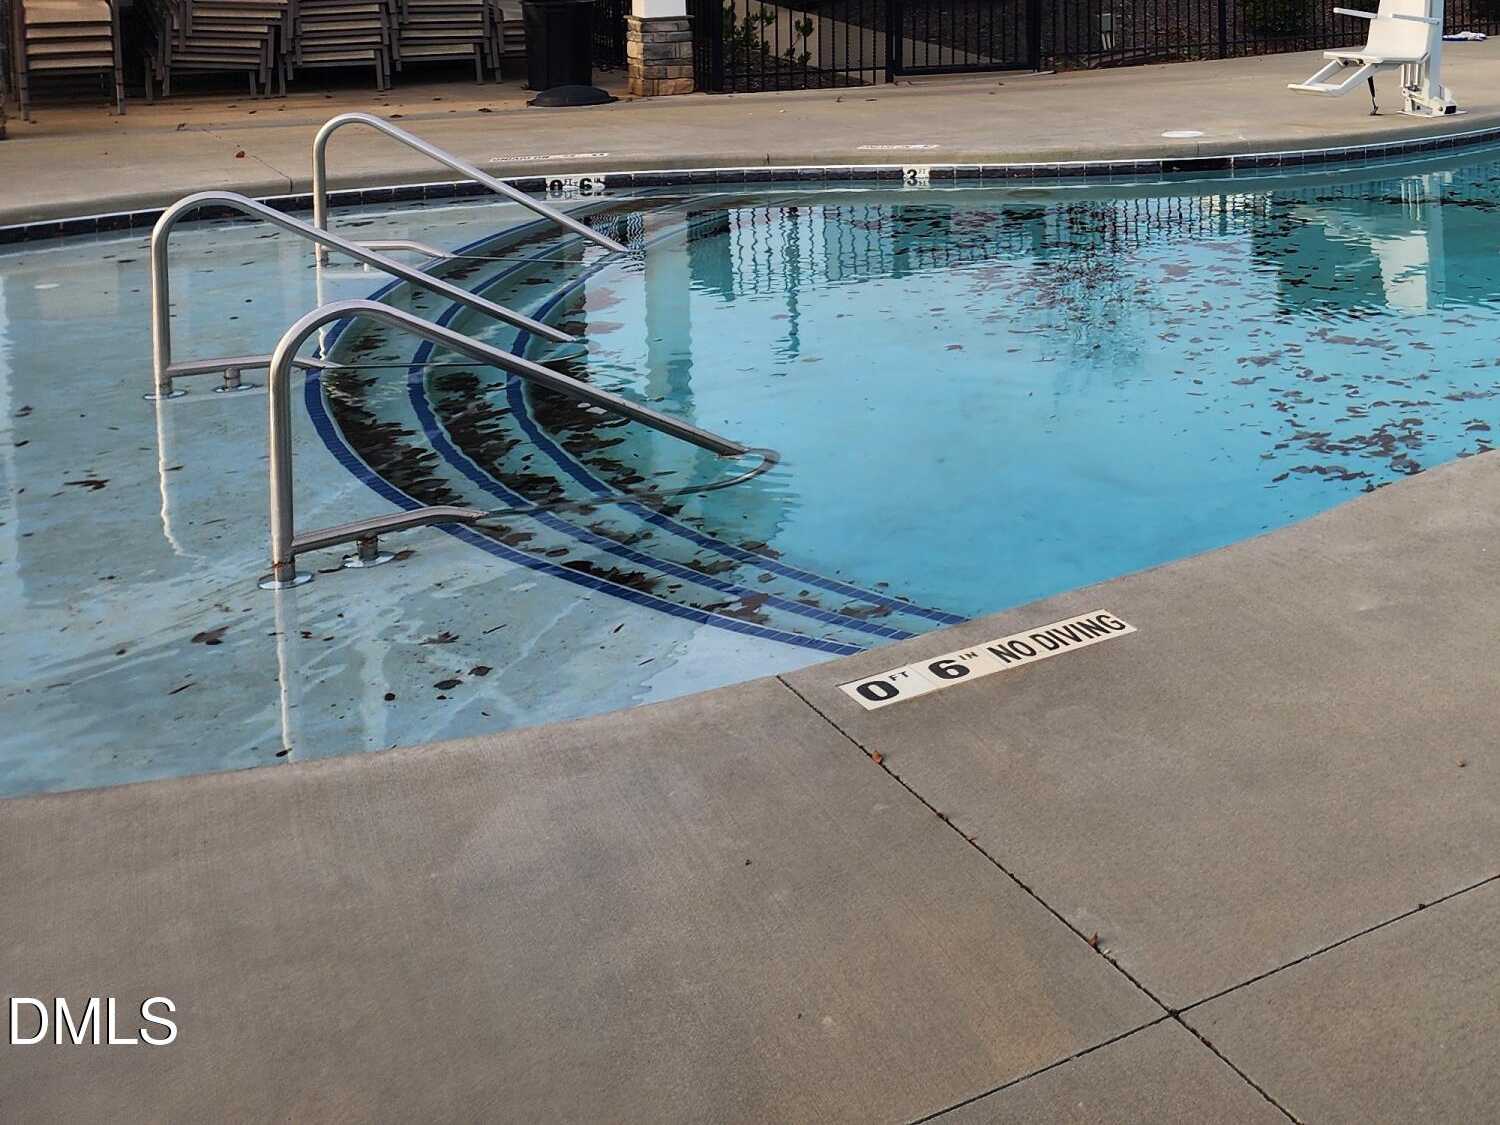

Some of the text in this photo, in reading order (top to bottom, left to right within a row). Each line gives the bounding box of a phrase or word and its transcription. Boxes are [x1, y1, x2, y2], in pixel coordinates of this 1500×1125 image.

[856, 614, 1126, 702] 0 FT 6 IN NO DIVING
